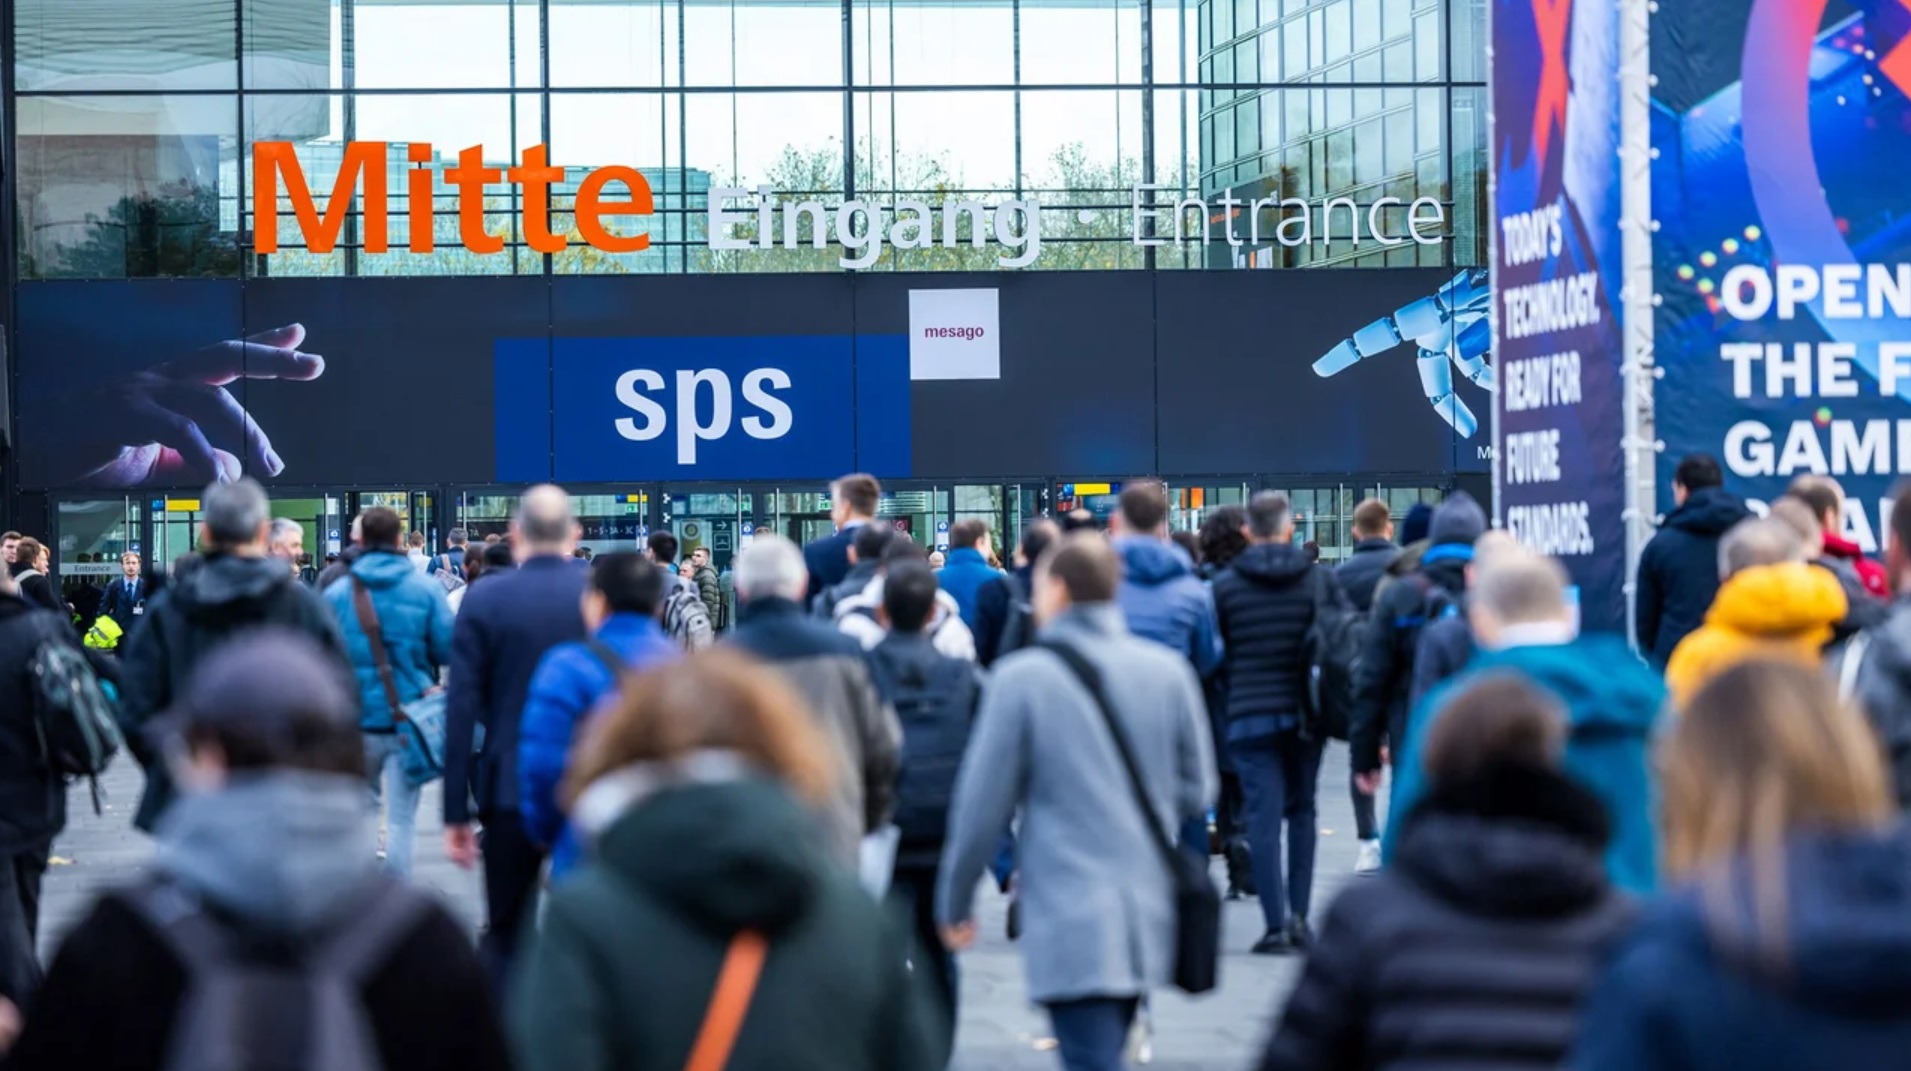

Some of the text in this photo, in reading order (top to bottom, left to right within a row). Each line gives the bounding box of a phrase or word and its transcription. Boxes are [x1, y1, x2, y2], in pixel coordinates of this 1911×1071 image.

[253, 141, 653, 254] Mitte
[708, 183, 1444, 269] Eingang Entrance
[1502, 203, 1562, 266] TODAY'S
[925, 326, 984, 340] mesago
[1503, 270, 1600, 339] TECHNOLOGY.
[1505, 350, 1581, 412] READY FOR
[1720, 342, 1858, 398] THE
[614, 367, 794, 465] sps
[1506, 428, 1561, 484] FUTURE
[74, 564, 111, 573] Entrance
